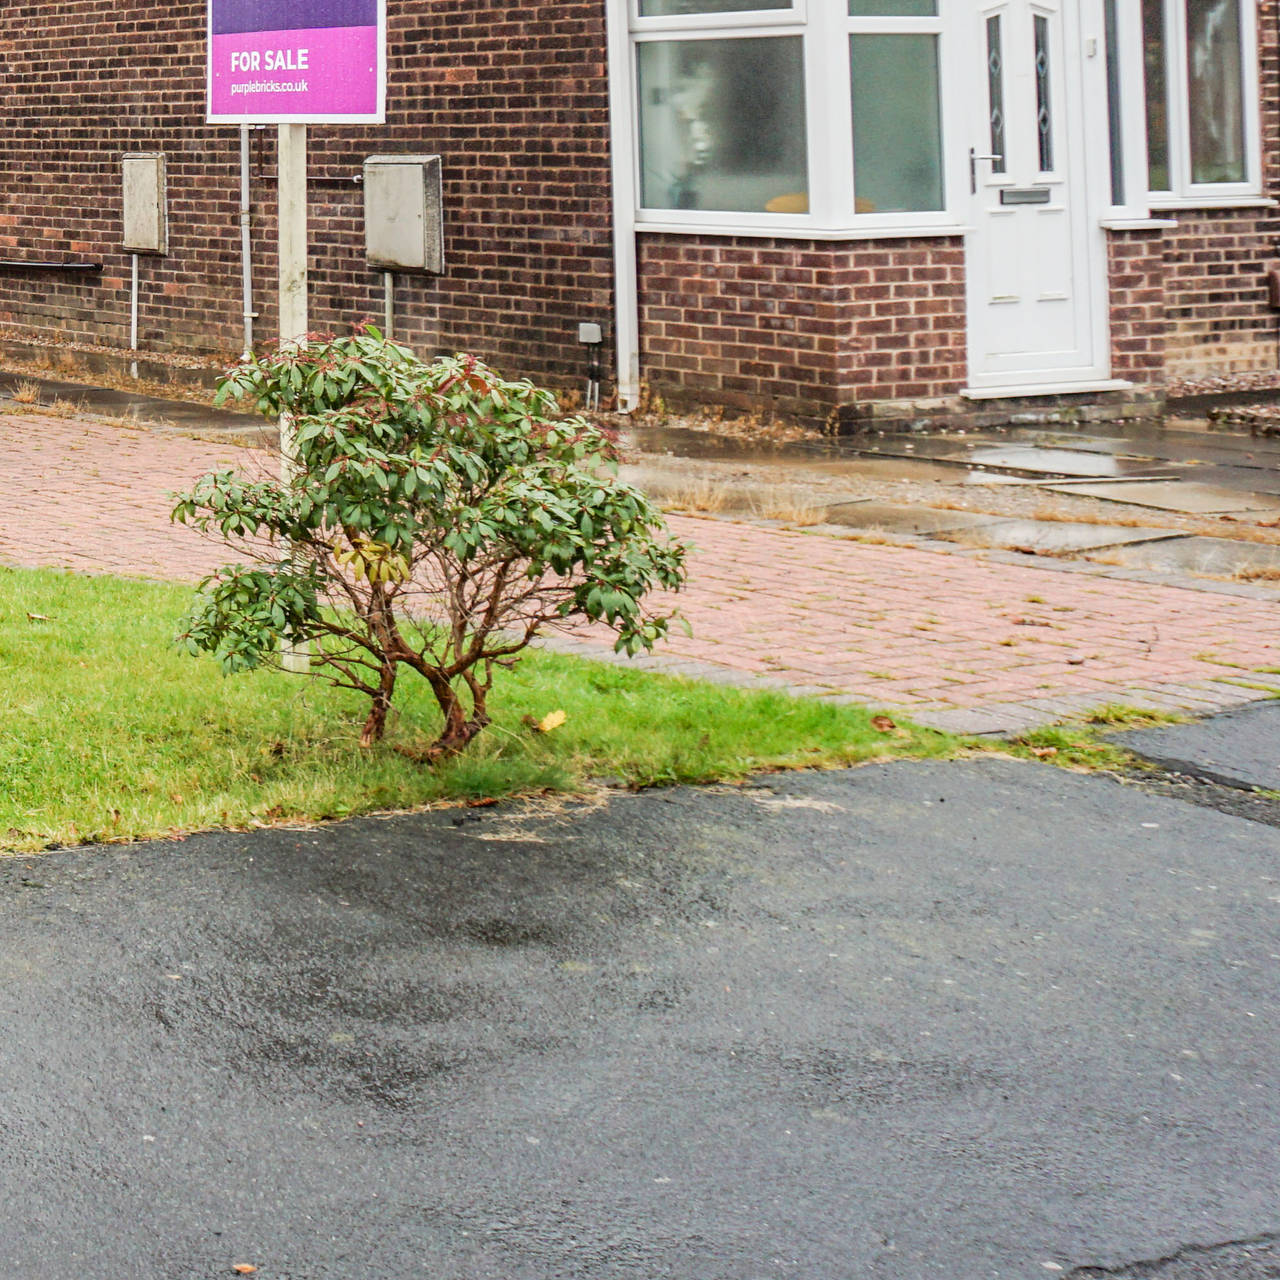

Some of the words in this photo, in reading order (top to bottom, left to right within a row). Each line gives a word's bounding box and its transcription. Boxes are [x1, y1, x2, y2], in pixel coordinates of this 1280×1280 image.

[231, 51, 260, 72] FOR
[264, 49, 309, 71] SALE
[231, 79, 308, 96] purplebricks.co.uk
